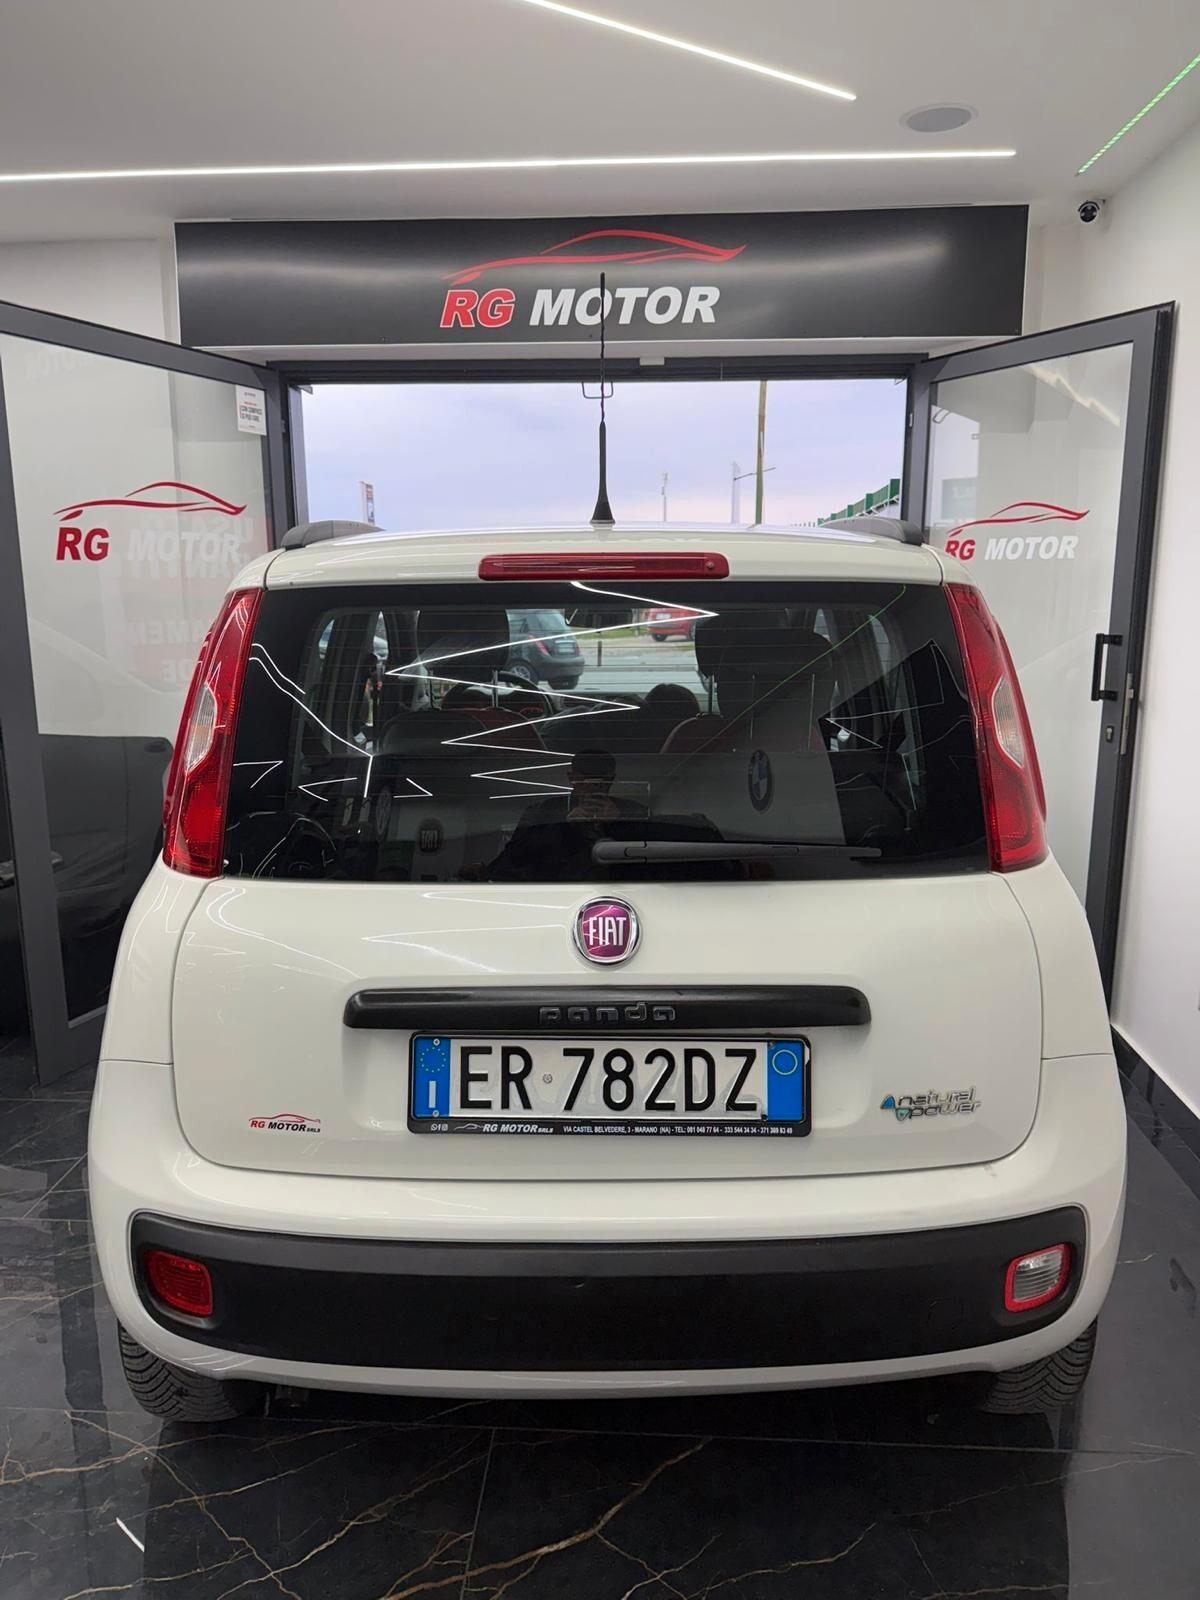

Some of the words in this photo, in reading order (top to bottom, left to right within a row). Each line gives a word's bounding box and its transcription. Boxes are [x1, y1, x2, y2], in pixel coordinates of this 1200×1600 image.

[440, 288, 515, 328] RG
[529, 286, 720, 326] MOTOR
[56, 527, 109, 561] RG
[128, 529, 241, 563] MOTOR
[945, 539, 976, 560] RG
[984, 536, 1078, 560] MOTOR
[588, 917, 626, 945] FIAT
[539, 1002, 676, 1025] panda
[460, 1045, 533, 1110] ER
[562, 1048, 757, 1112] 782DZ
[898, 1088, 974, 1106] natural
[250, 1120, 265, 1129] RG
[268, 1121, 306, 1132] MOTOR
[482, 1124, 498, 1132] RG
[500, 1124, 537, 1133] MOTOR
[594, 1126, 627, 1134] BELVEDERE,
[635, 1126, 658, 1134] MARANO
[660, 1126, 671, 1134] (NA)
[724, 1126, 734, 1134] 333
